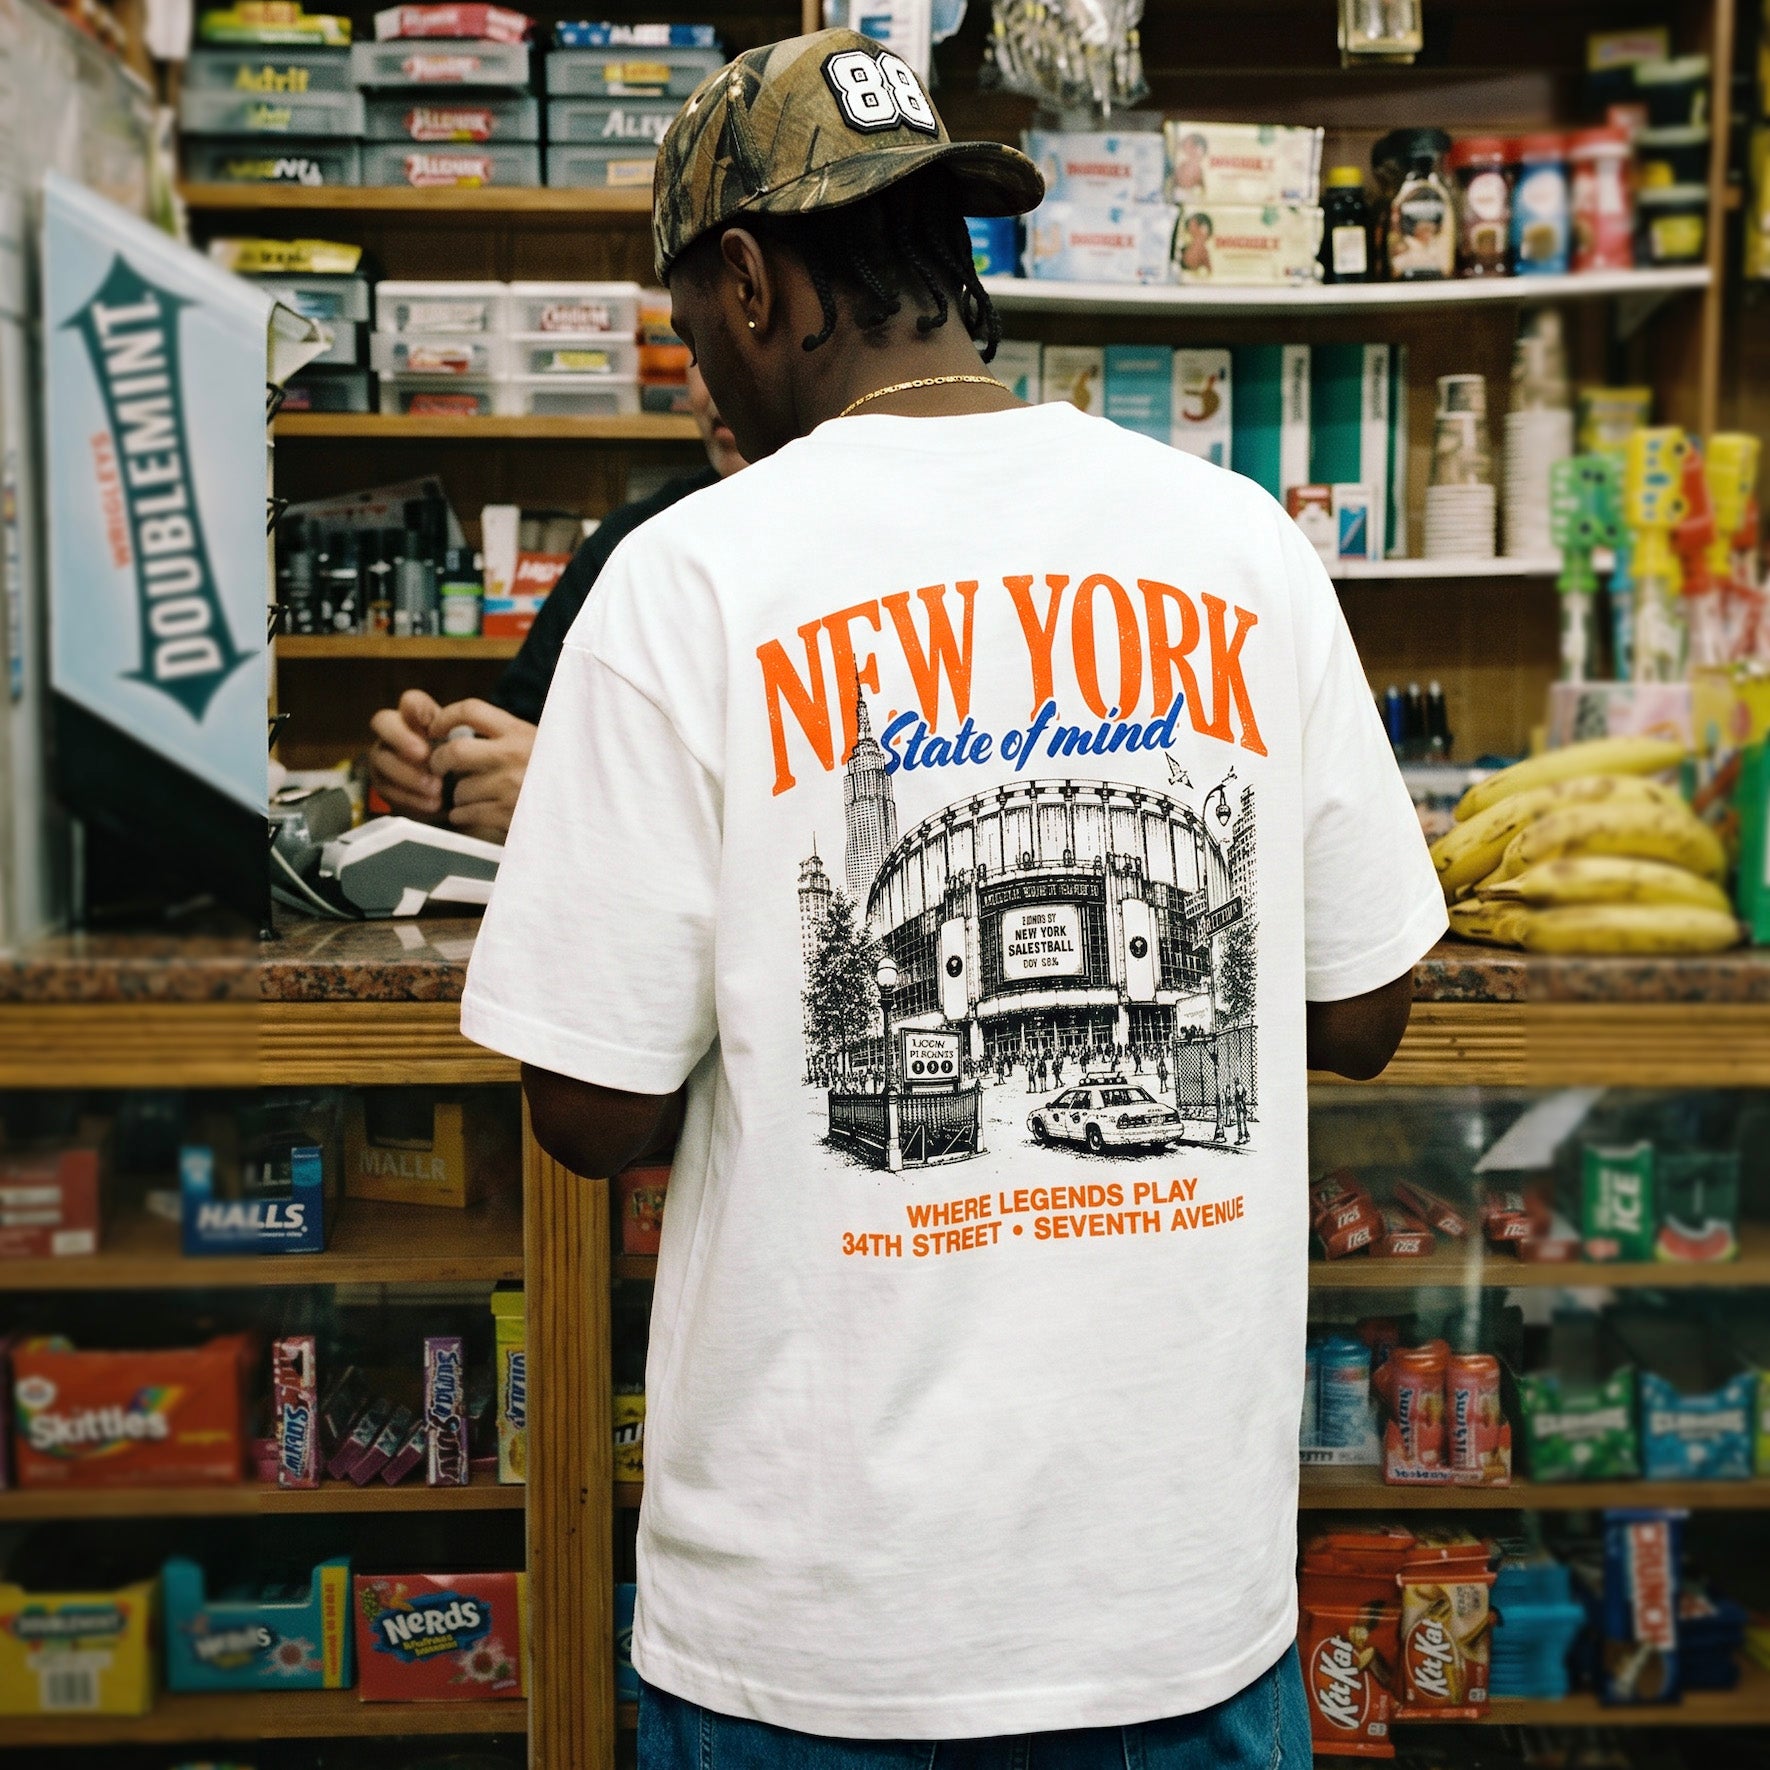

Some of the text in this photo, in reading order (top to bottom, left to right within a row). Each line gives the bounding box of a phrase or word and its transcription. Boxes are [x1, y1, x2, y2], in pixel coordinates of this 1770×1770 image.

[823, 49, 937, 133] 88
[90, 292, 224, 681] DOUBLEMINT
[756, 573, 1268, 797] NEW YORK
[881, 692, 1186, 776] State of mind
[1008, 940, 1074, 957] SALESTBALL
[1015, 925, 1067, 941] NEW YORK
[197, 1203, 306, 1230] HALLS
[842, 1195, 1244, 1258] 34TH STREET SEVENTH AVENUE
[906, 1177, 1199, 1229] WHERE LEGENDS PLAY
[28, 1402, 169, 1450] Skittles
